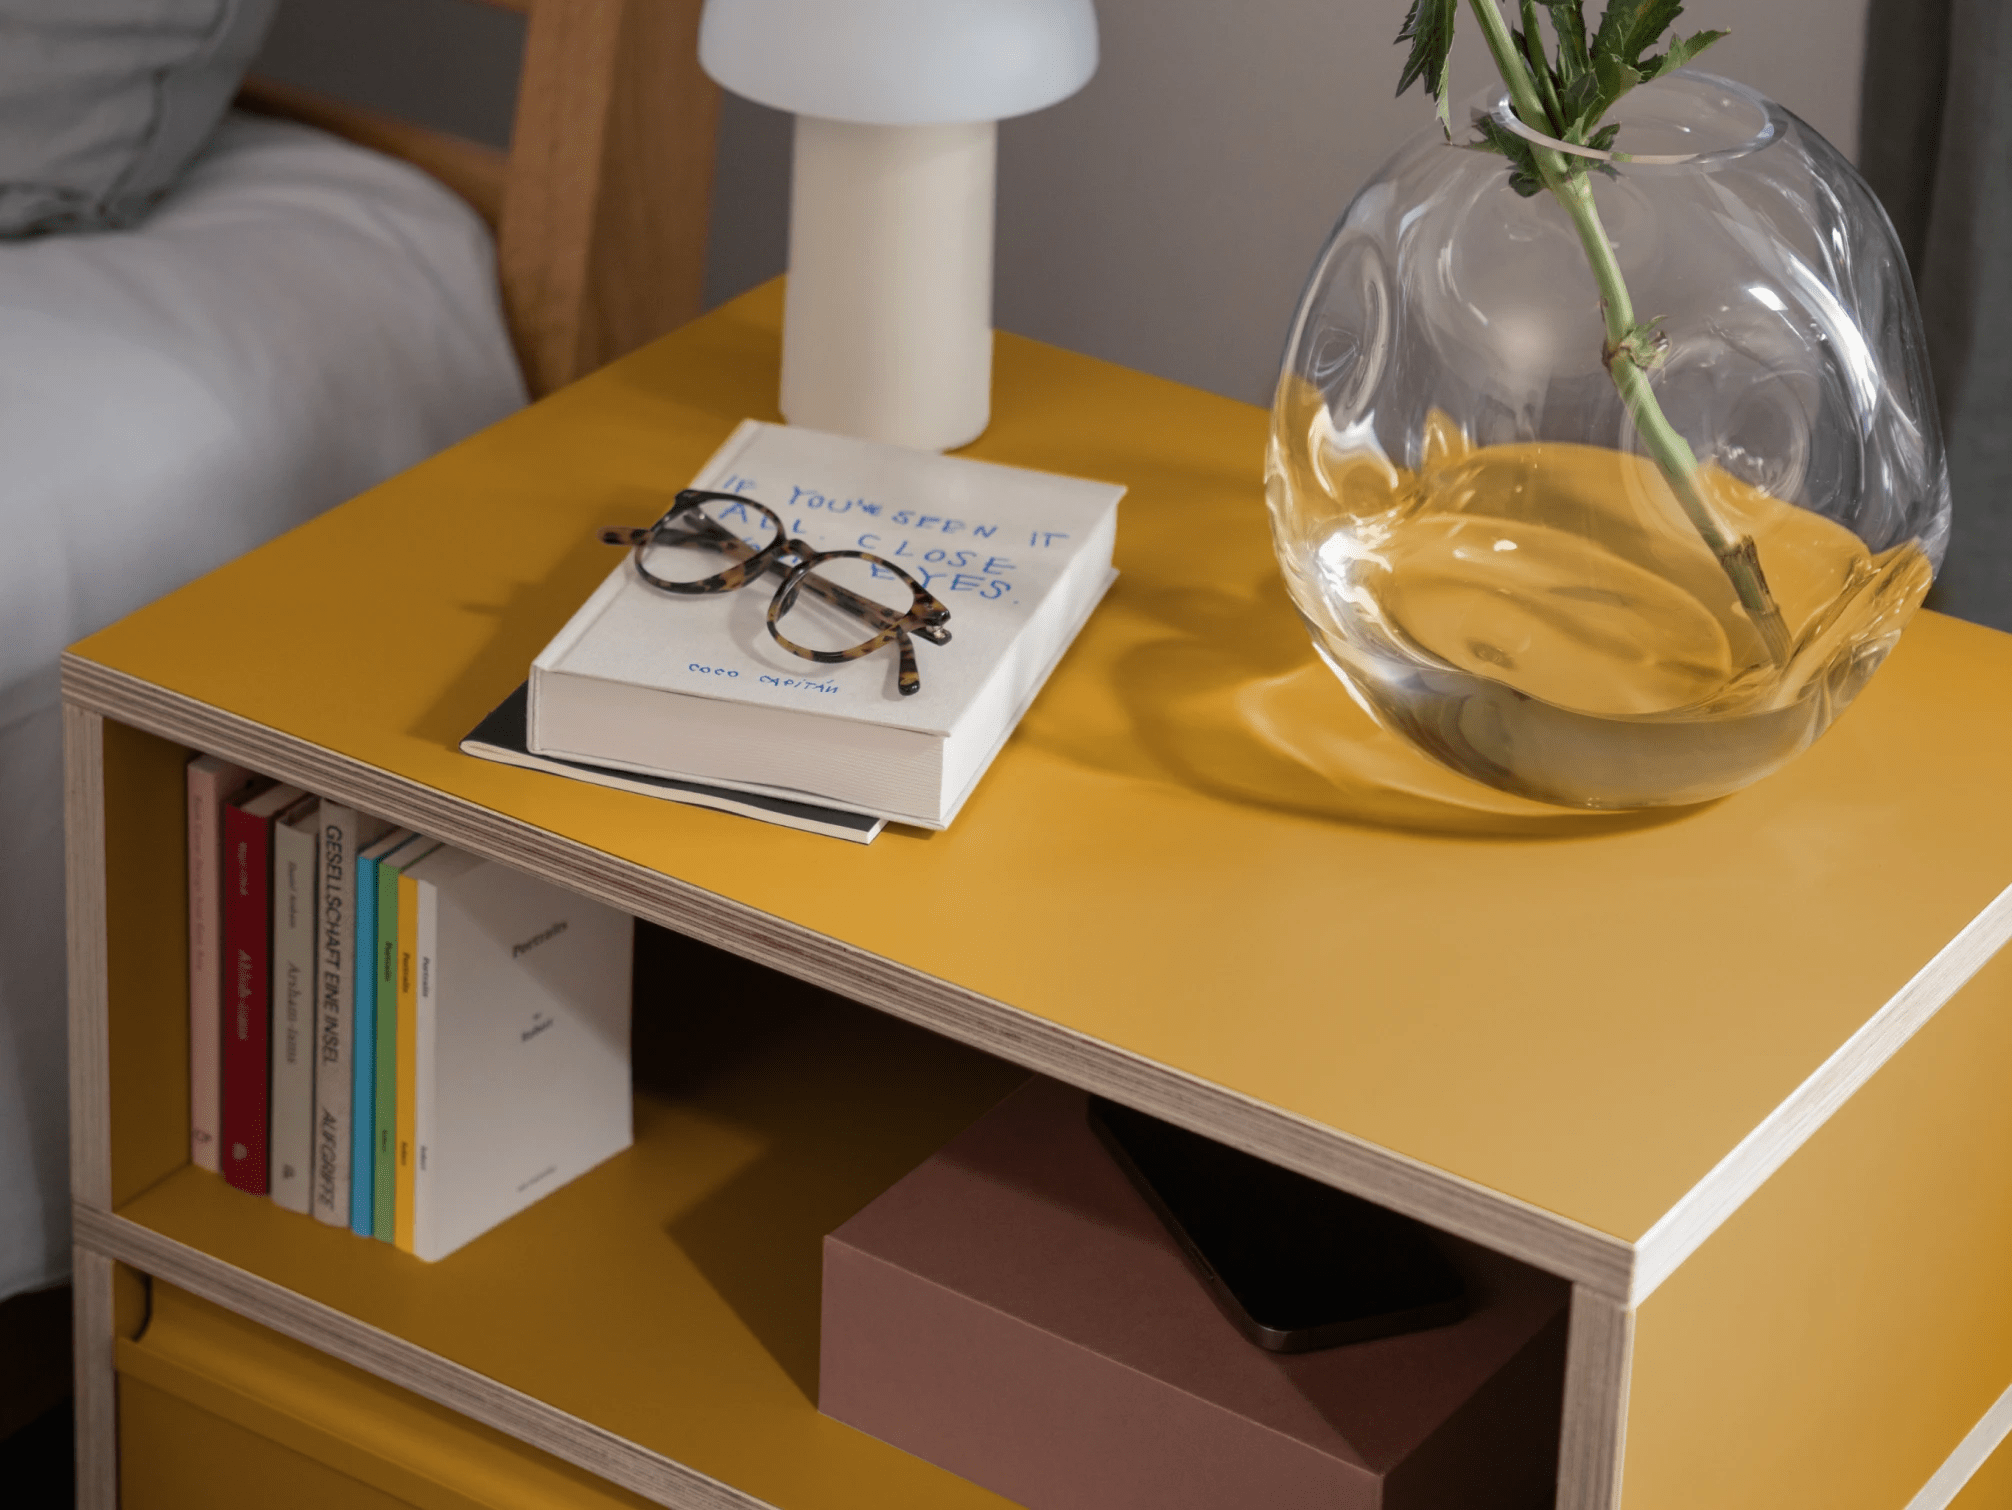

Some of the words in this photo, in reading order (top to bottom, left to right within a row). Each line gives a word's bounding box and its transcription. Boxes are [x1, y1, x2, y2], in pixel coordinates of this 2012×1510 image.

[857, 533, 1017, 575] CLOSE
[1029, 530, 1070, 548] IT
[688, 663, 740, 678] COCO
[325, 825, 343, 970] GESELLSCHAFT
[323, 972, 341, 1013] EINE
[321, 1015, 340, 1067] INSEL
